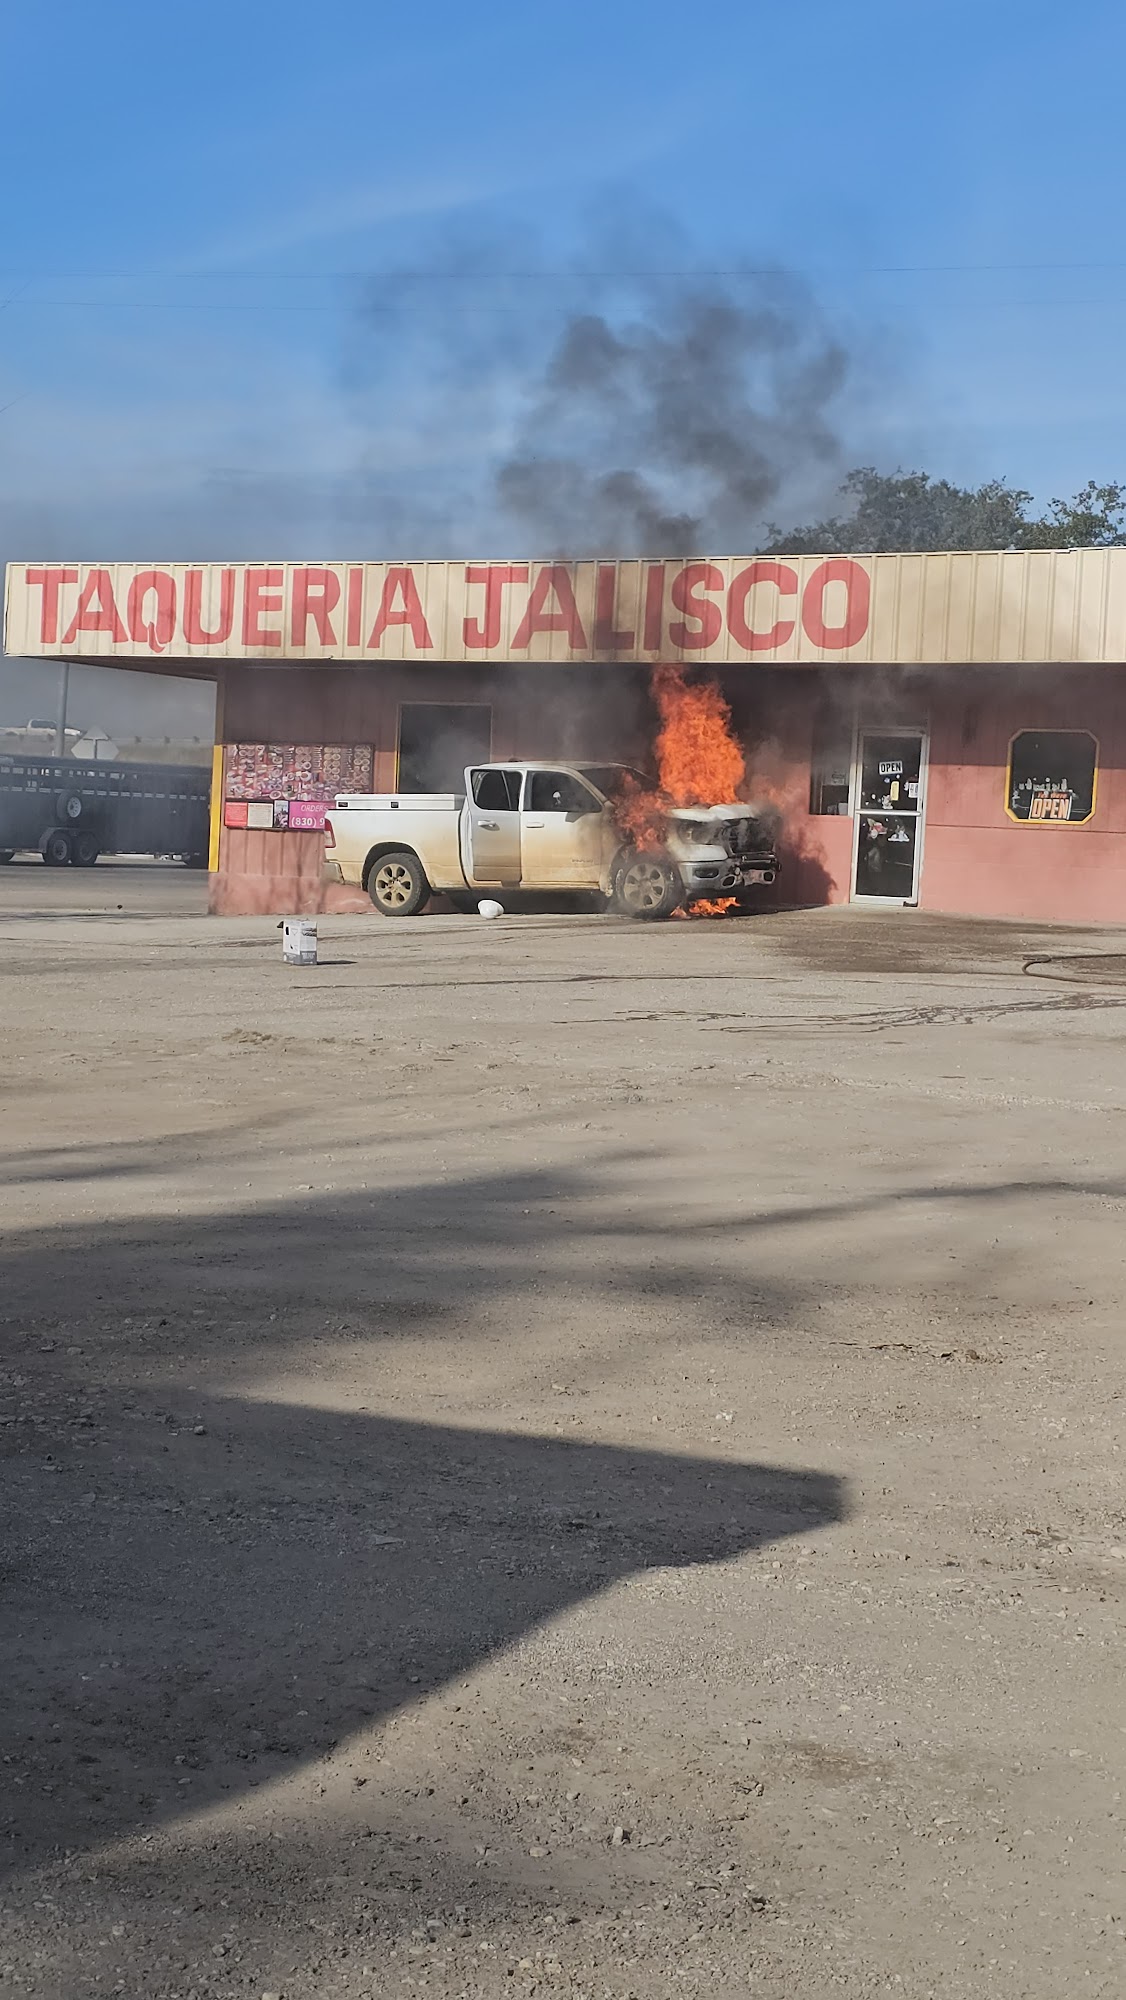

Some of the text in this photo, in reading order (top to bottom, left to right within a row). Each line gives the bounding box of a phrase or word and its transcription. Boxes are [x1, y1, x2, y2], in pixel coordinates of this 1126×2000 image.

[26, 560, 871, 653] TAQUERIA JALISCO
[881, 762, 902, 773] OPEN
[1031, 798, 1070, 819] OPEN
[291, 817, 316, 828] (830)
